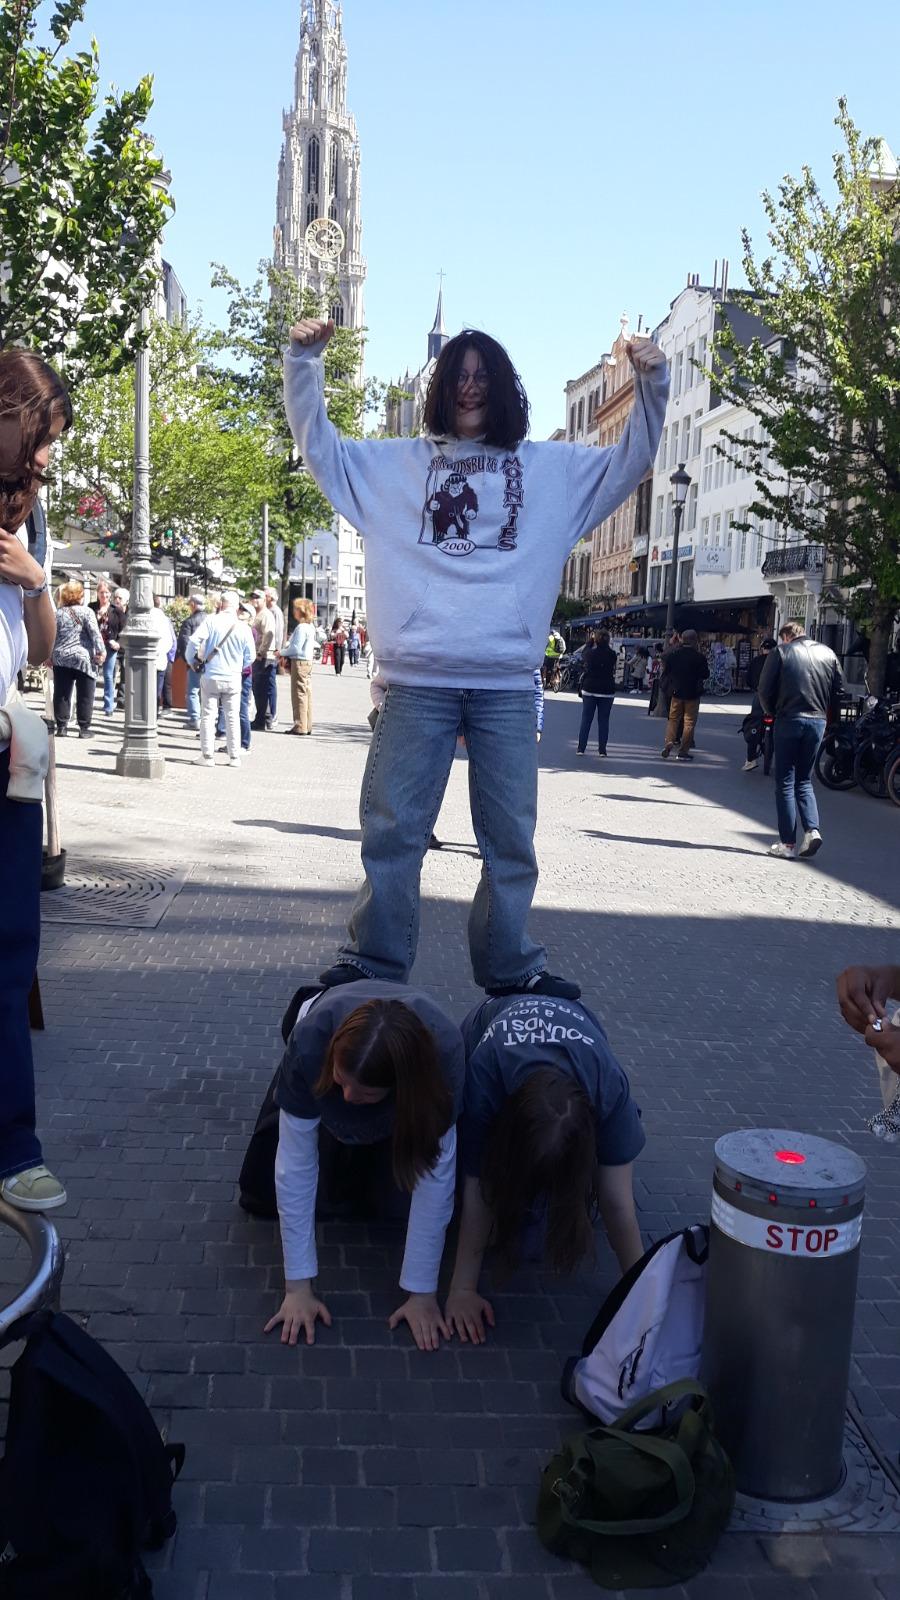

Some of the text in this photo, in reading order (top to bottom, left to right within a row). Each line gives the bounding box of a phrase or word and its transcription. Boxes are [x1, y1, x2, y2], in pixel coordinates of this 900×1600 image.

[498, 456, 523, 551] MOUNTIES
[442, 542, 471, 552] 2000
[507, 1000, 585, 1021] PROBL
[508, 1007, 554, 1018] a you
[475, 1017, 595, 1049] SOUNDS LIK
[503, 1029, 560, 1046] THAT
[766, 1224, 839, 1253] STOP
